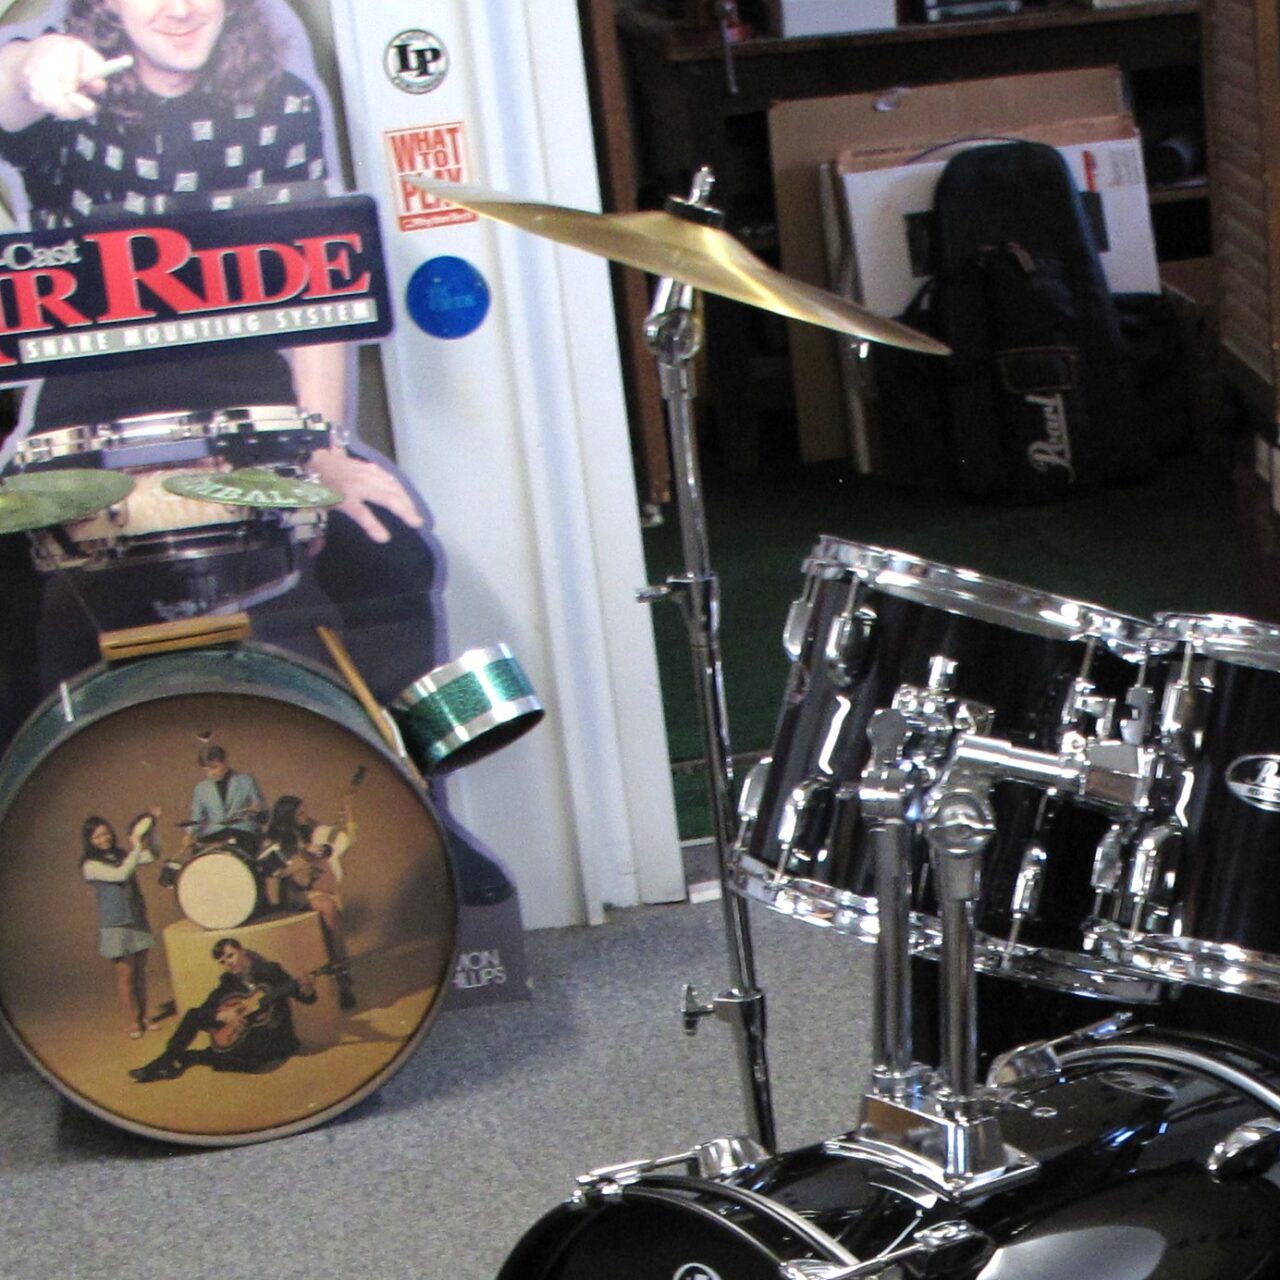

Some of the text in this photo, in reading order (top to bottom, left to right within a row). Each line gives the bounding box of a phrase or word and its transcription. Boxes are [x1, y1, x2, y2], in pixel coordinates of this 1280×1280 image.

[394, 44, 442, 77] LP
[390, 128, 461, 173] WHAT
[420, 149, 449, 169] TO
[84, 226, 373, 324] RIDE
[26, 302, 371, 359] SNARE MOUNTING SYSTEM
